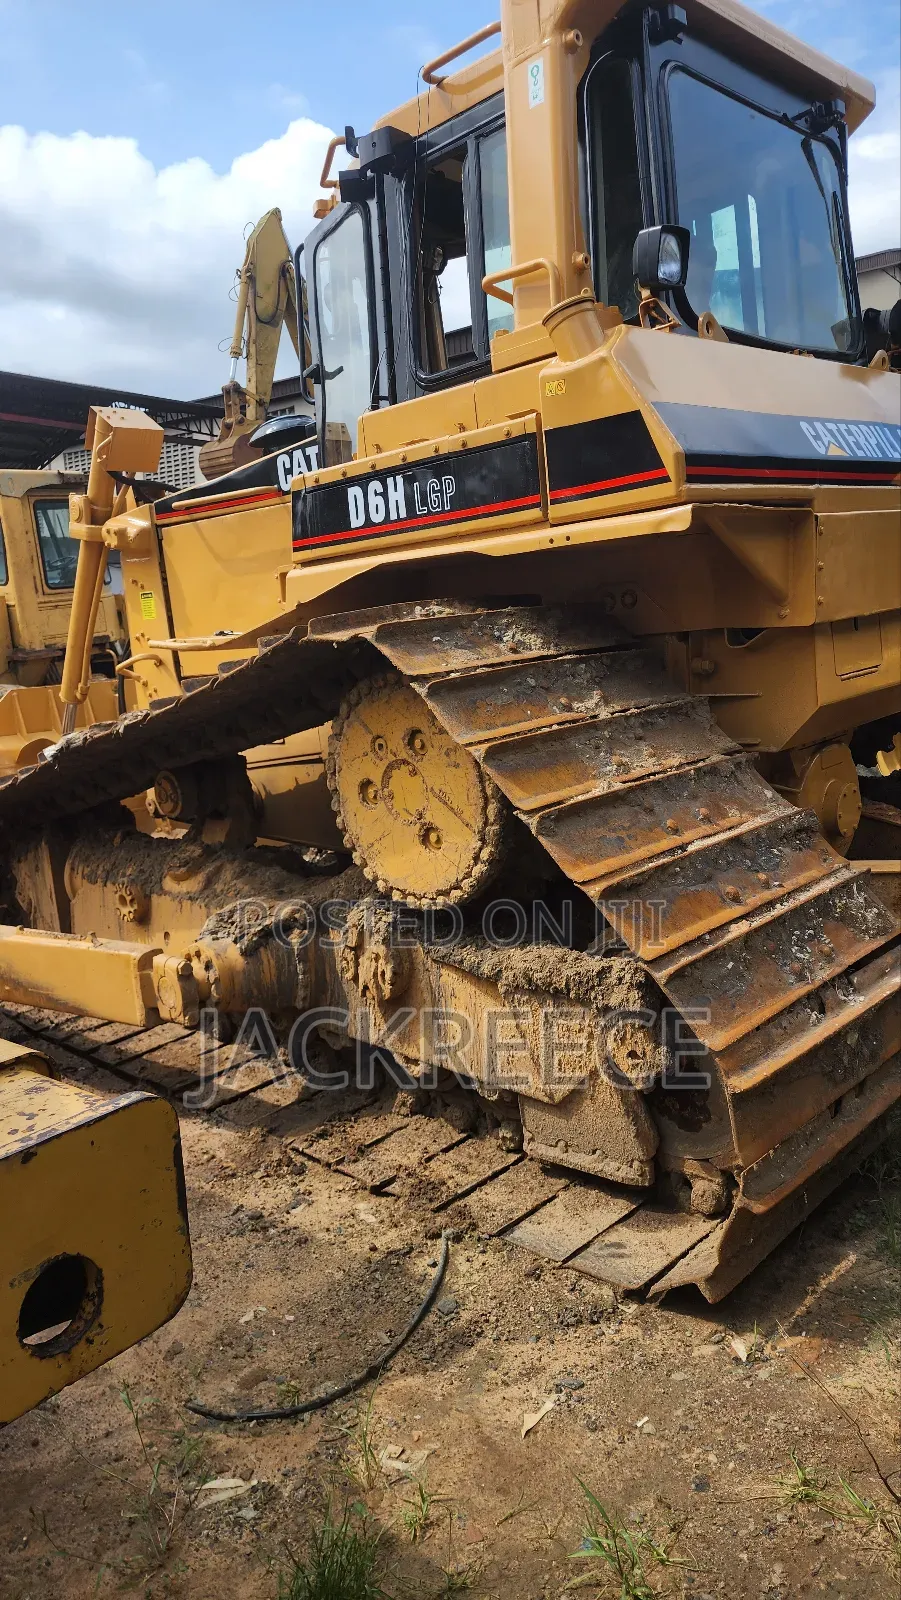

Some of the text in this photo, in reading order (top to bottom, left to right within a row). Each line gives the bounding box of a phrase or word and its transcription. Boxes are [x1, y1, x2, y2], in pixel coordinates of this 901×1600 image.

[800, 421, 901, 459] CATERPILL
[277, 445, 318, 491] CAT
[347, 474, 456, 529] D6H LGP
